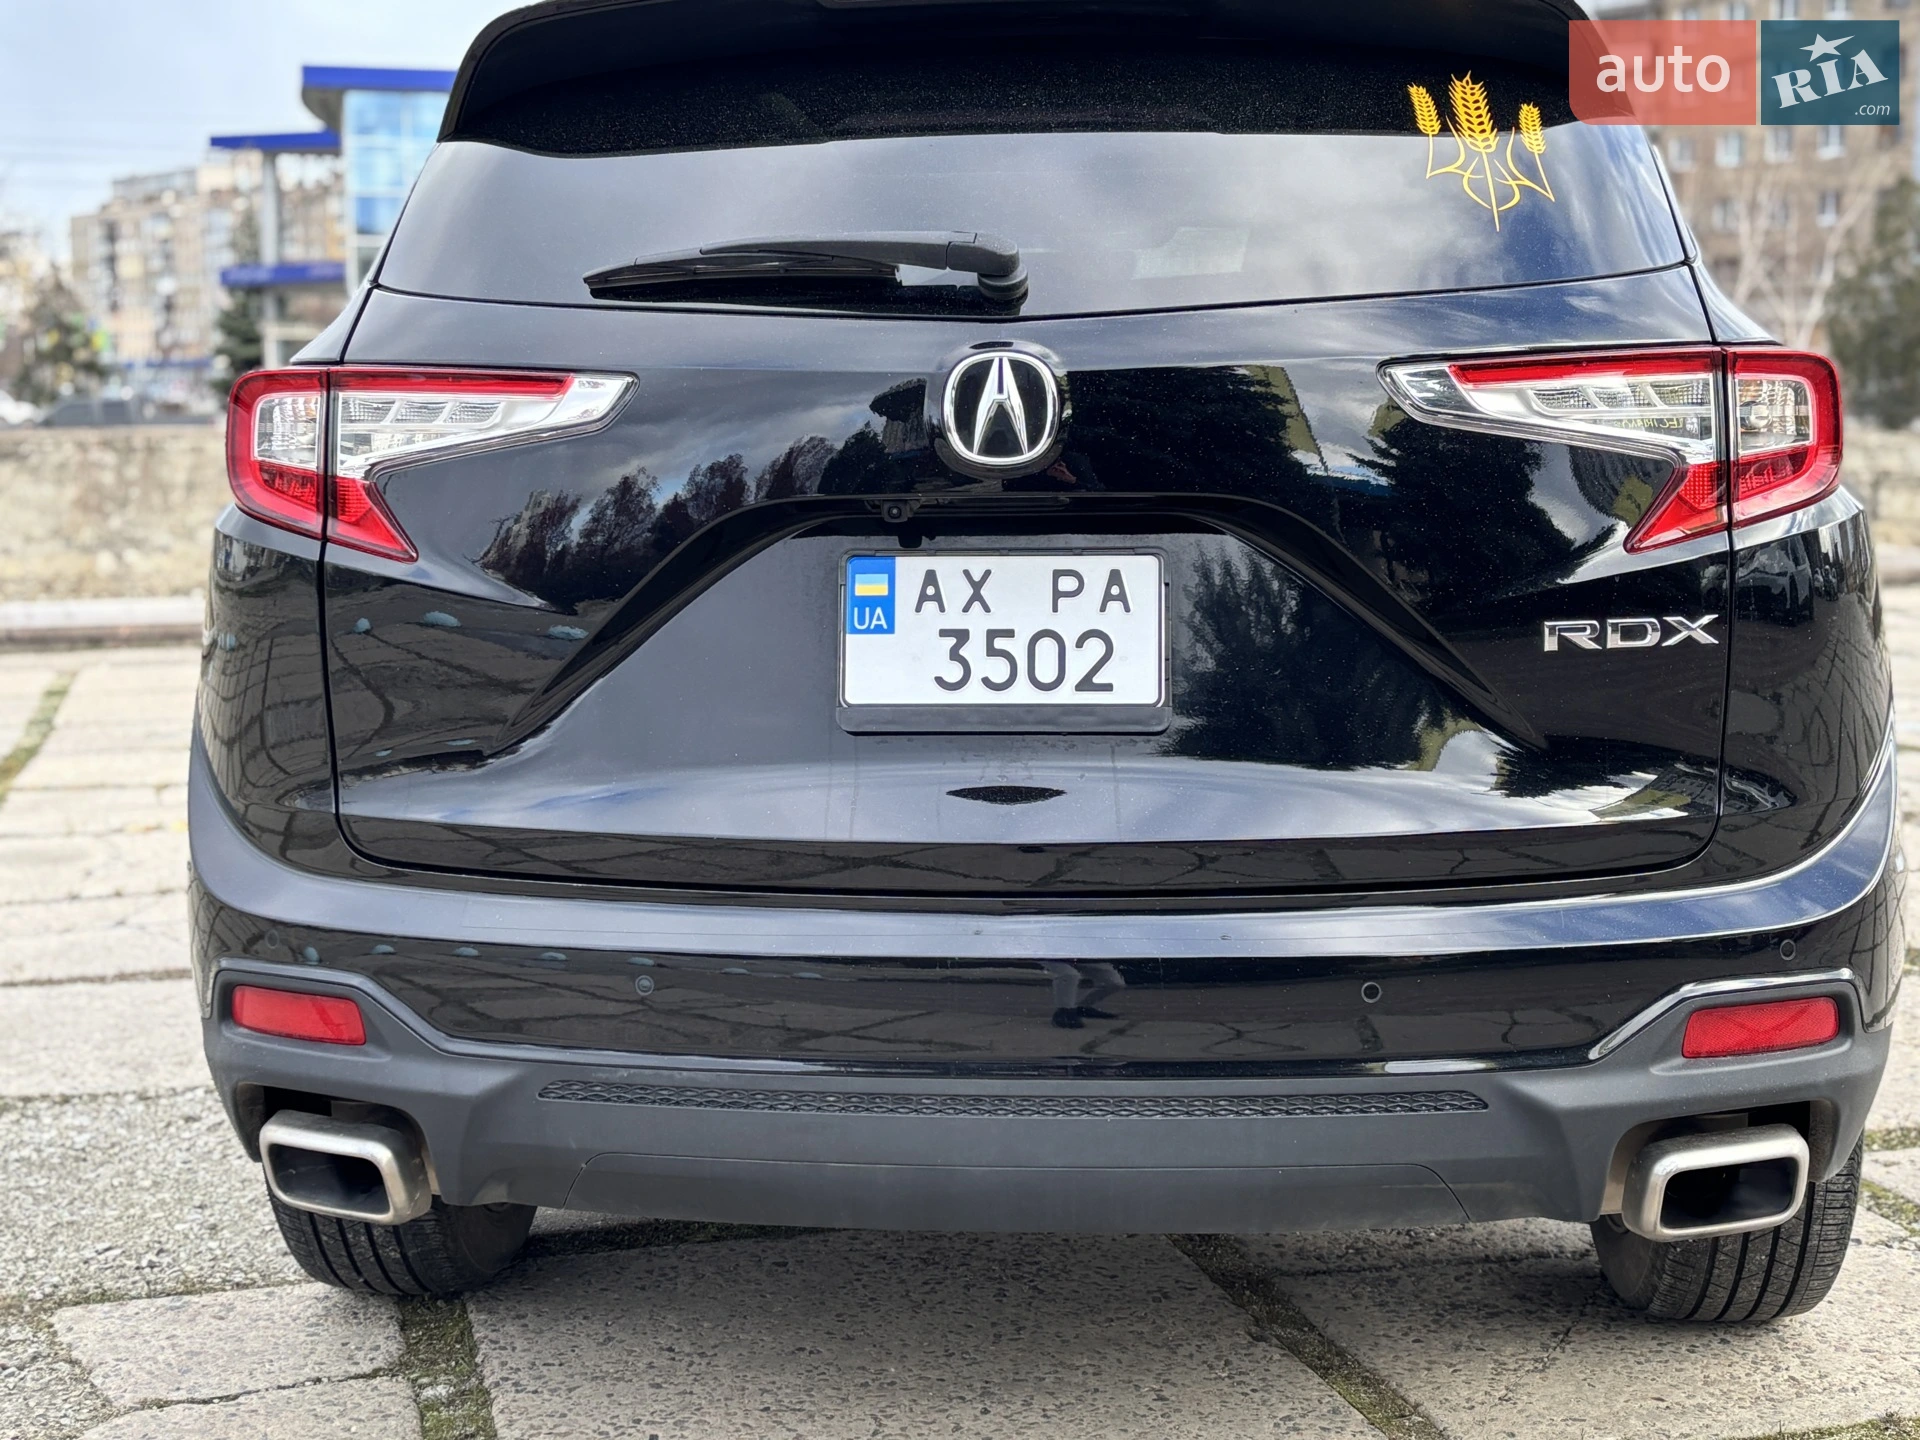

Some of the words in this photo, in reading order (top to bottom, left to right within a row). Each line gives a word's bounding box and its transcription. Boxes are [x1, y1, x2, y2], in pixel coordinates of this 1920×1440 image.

[914, 568, 993, 614] AX
[1051, 568, 1132, 614] PA
[853, 607, 888, 630] UA
[1543, 614, 1719, 652] RDX
[933, 628, 1114, 692] 3502
